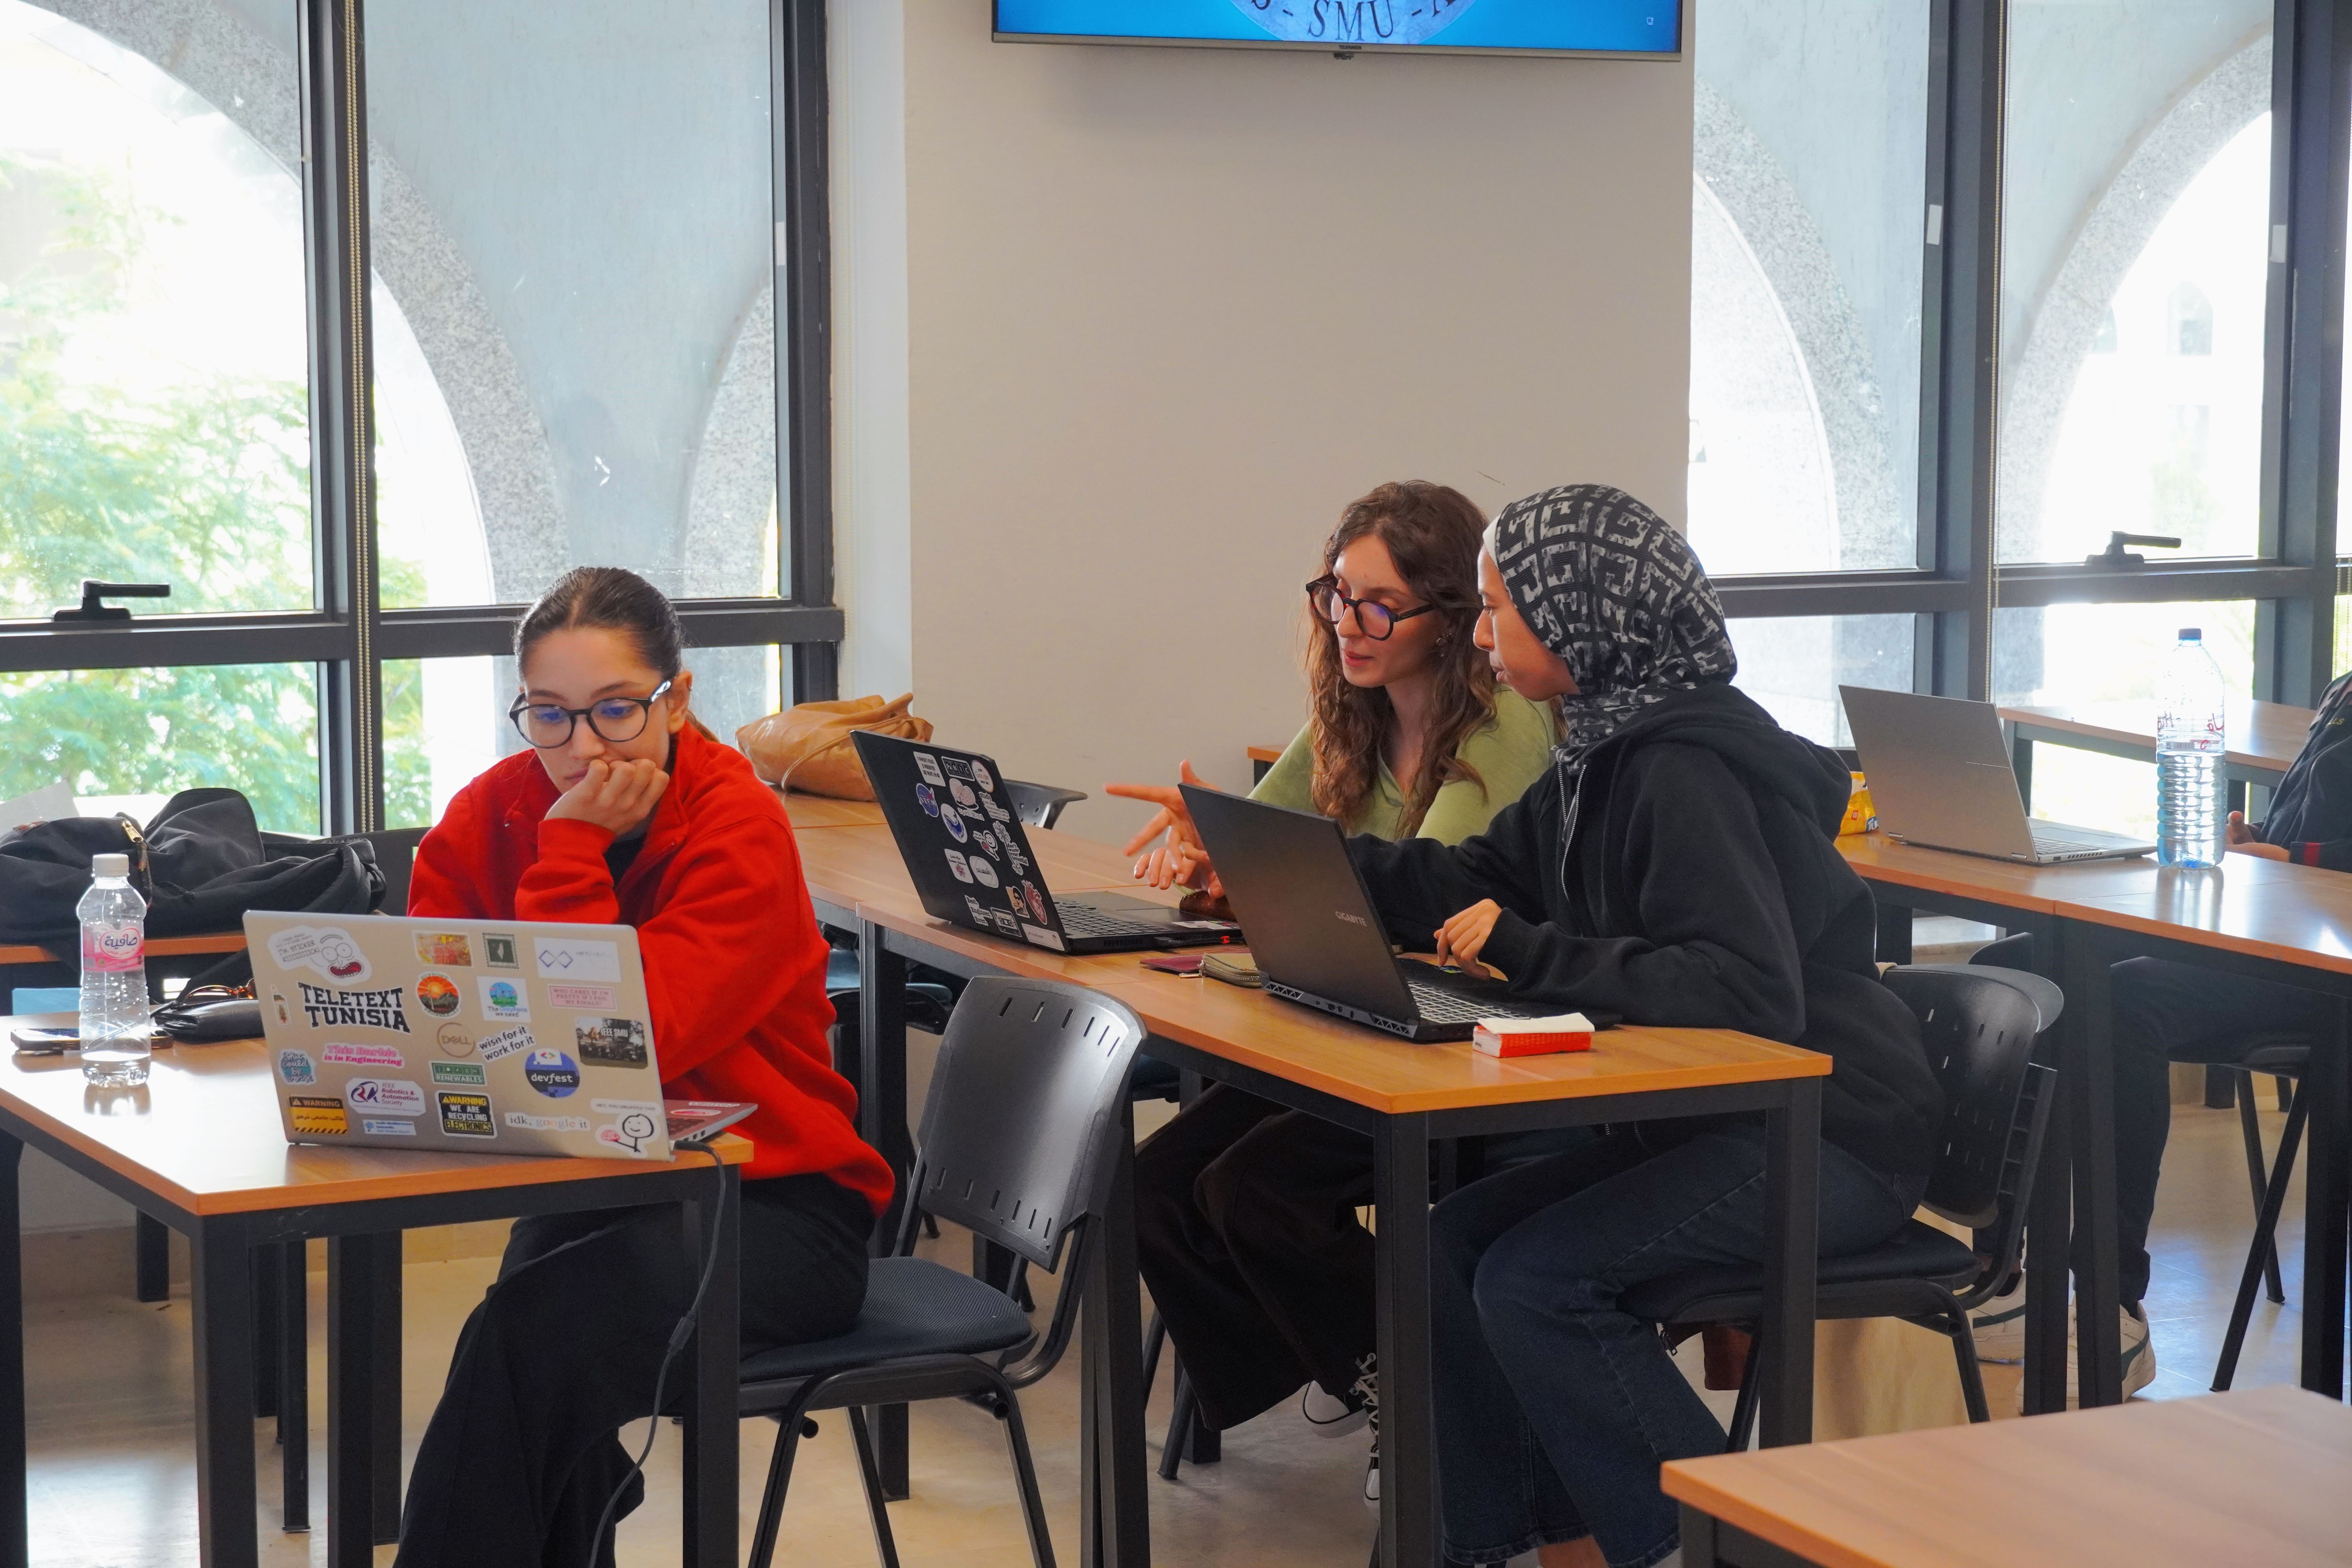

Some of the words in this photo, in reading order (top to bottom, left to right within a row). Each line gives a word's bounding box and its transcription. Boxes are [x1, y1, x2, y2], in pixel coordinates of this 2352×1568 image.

[1308, 0, 1393, 41] SMU
[920, 797, 936, 806] STEM
[1867, 818, 1879, 831] TU
[1335, 911, 1367, 926] GIGABYTE
[105, 934, 137, 949] صافية
[298, 982, 403, 1008] TELETEXT
[305, 1006, 410, 1033] TUNISIA
[614, 1029, 628, 1037] SMU
[442, 1035, 471, 1045] DELL
[479, 1037, 502, 1050] wish
[503, 1030, 516, 1041] for
[485, 1045, 510, 1060] work
[510, 1041, 524, 1051] for
[526, 1036, 534, 1044] it
[345, 1056, 402, 1066] Engineering
[436, 1074, 483, 1083] RENEWABLES
[531, 1073, 573, 1084] devfest
[449, 1096, 487, 1106] WARNING
[448, 1112, 488, 1122] RECYCLING
[510, 1115, 532, 1127] idk,
[535, 1117, 576, 1129] google
[579, 1119, 588, 1129] it
[446, 1120, 491, 1131] ELECTRONICS
